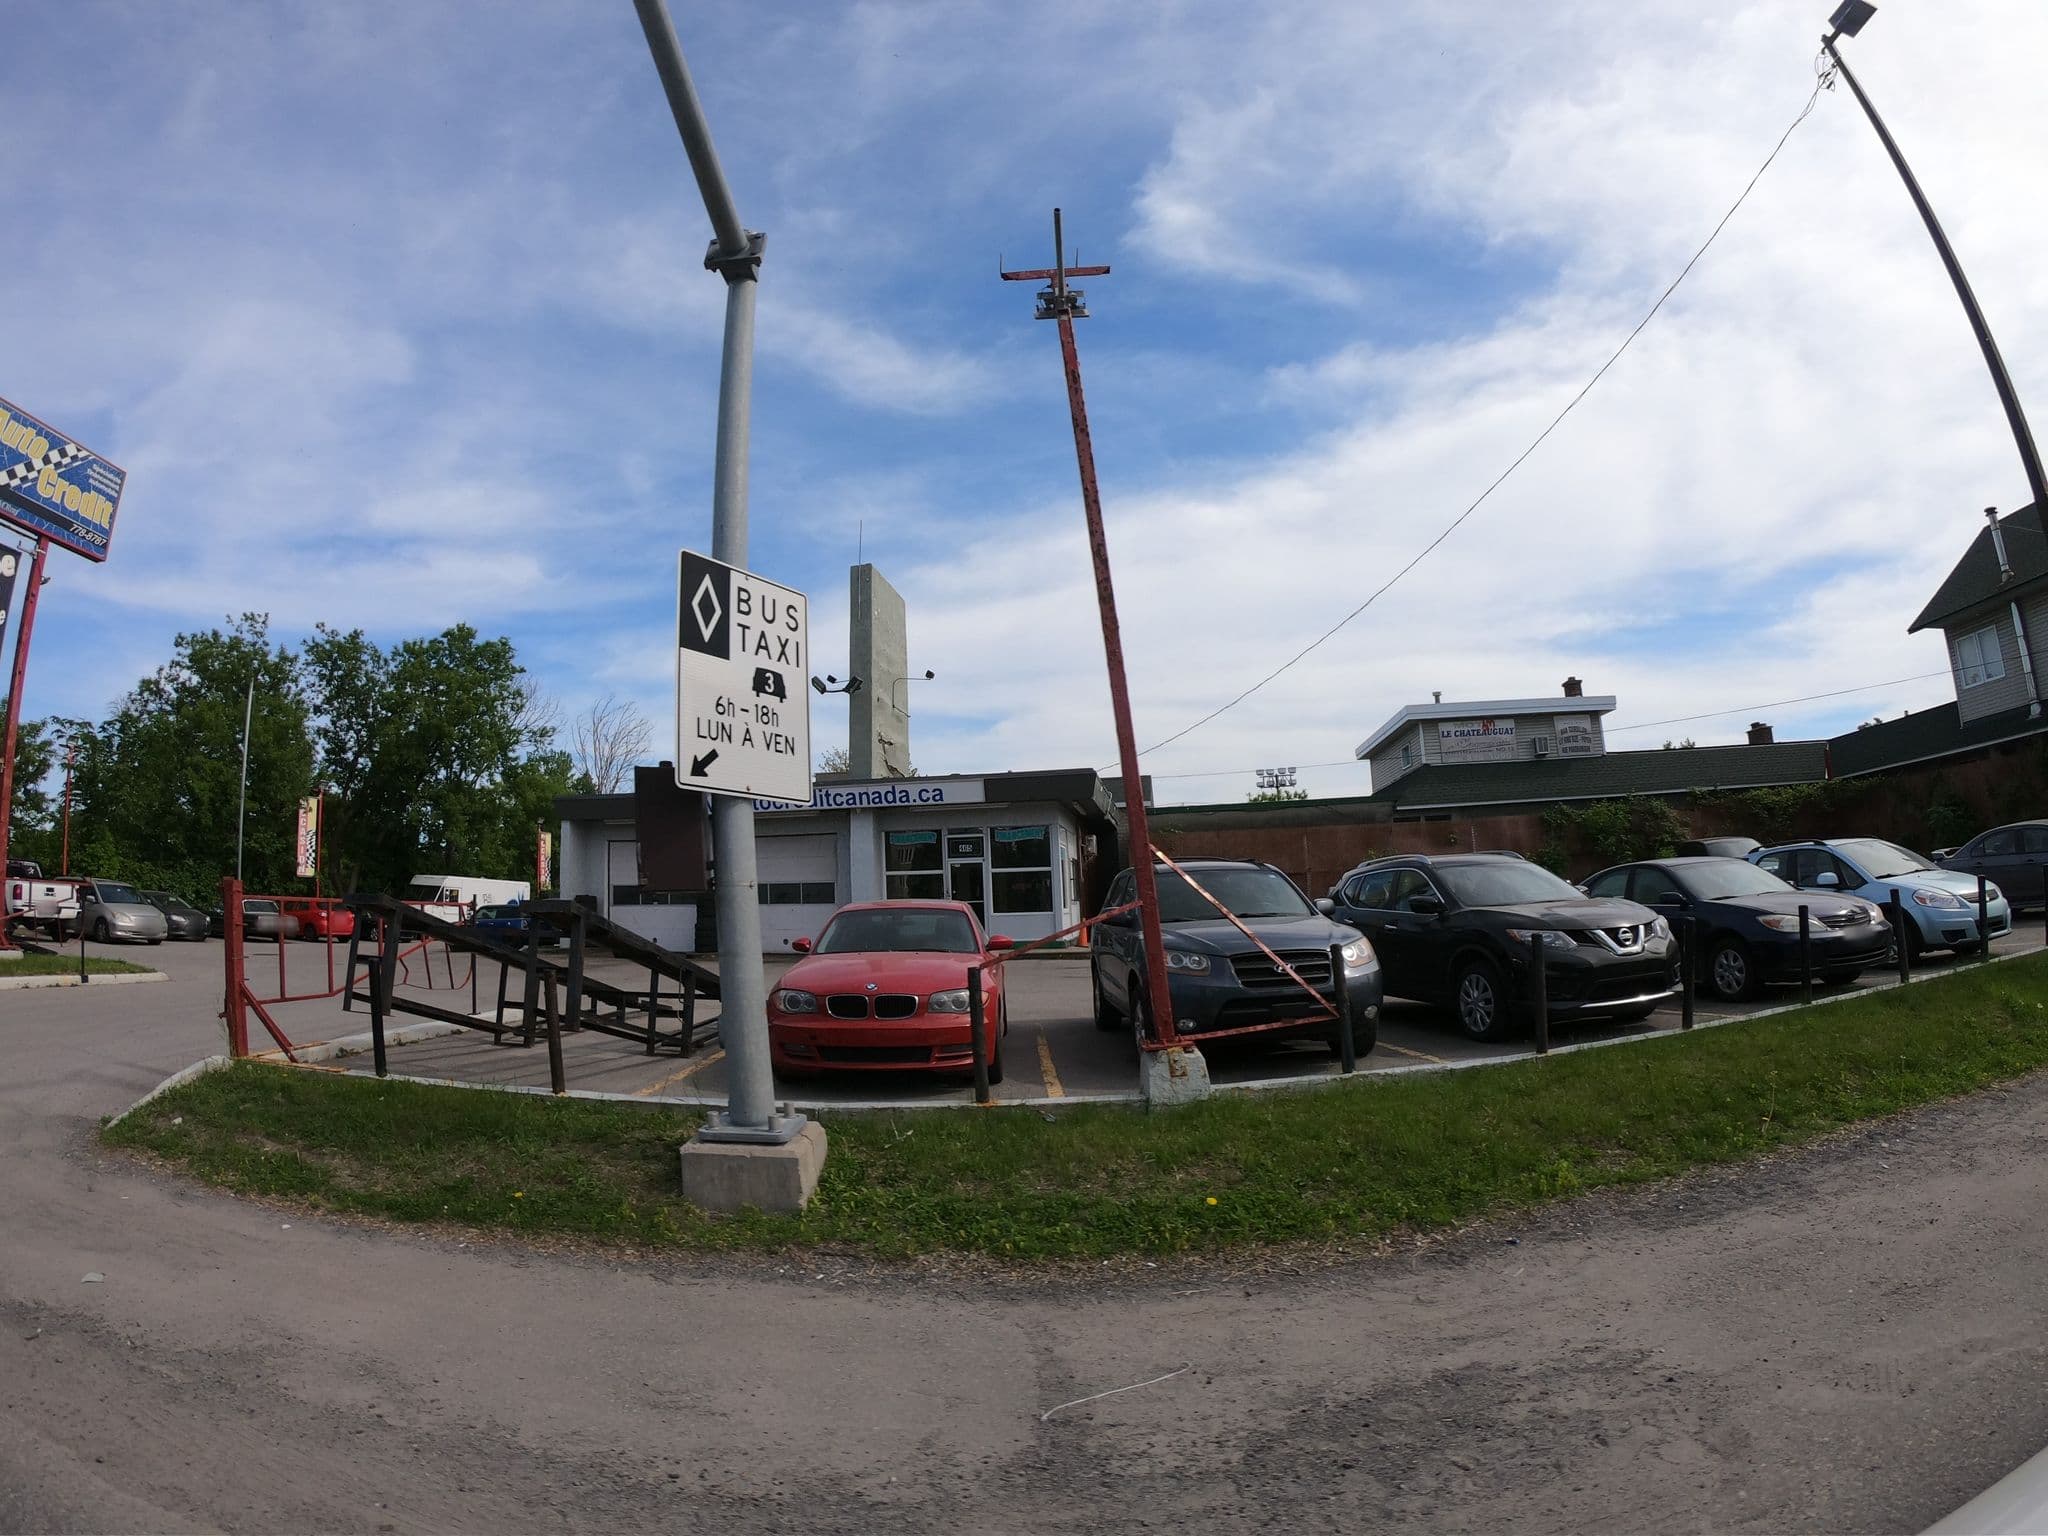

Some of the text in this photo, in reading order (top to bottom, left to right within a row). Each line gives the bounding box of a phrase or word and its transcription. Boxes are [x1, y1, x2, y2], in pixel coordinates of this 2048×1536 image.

[37, 465, 114, 528] Credit
[69, 523, 107, 546] 778-8787
[737, 586, 799, 632] BUS
[737, 622, 800, 668] TAXI
[764, 672, 775, 693] 3
[715, 695, 735, 718] 6h
[754, 703, 779, 728] 18h
[697, 716, 795, 756] LUN À VEN
[1441, 727, 1515, 738] LE CHATEAUGUAY
[752, 784, 944, 811] tocditcanada.ca
